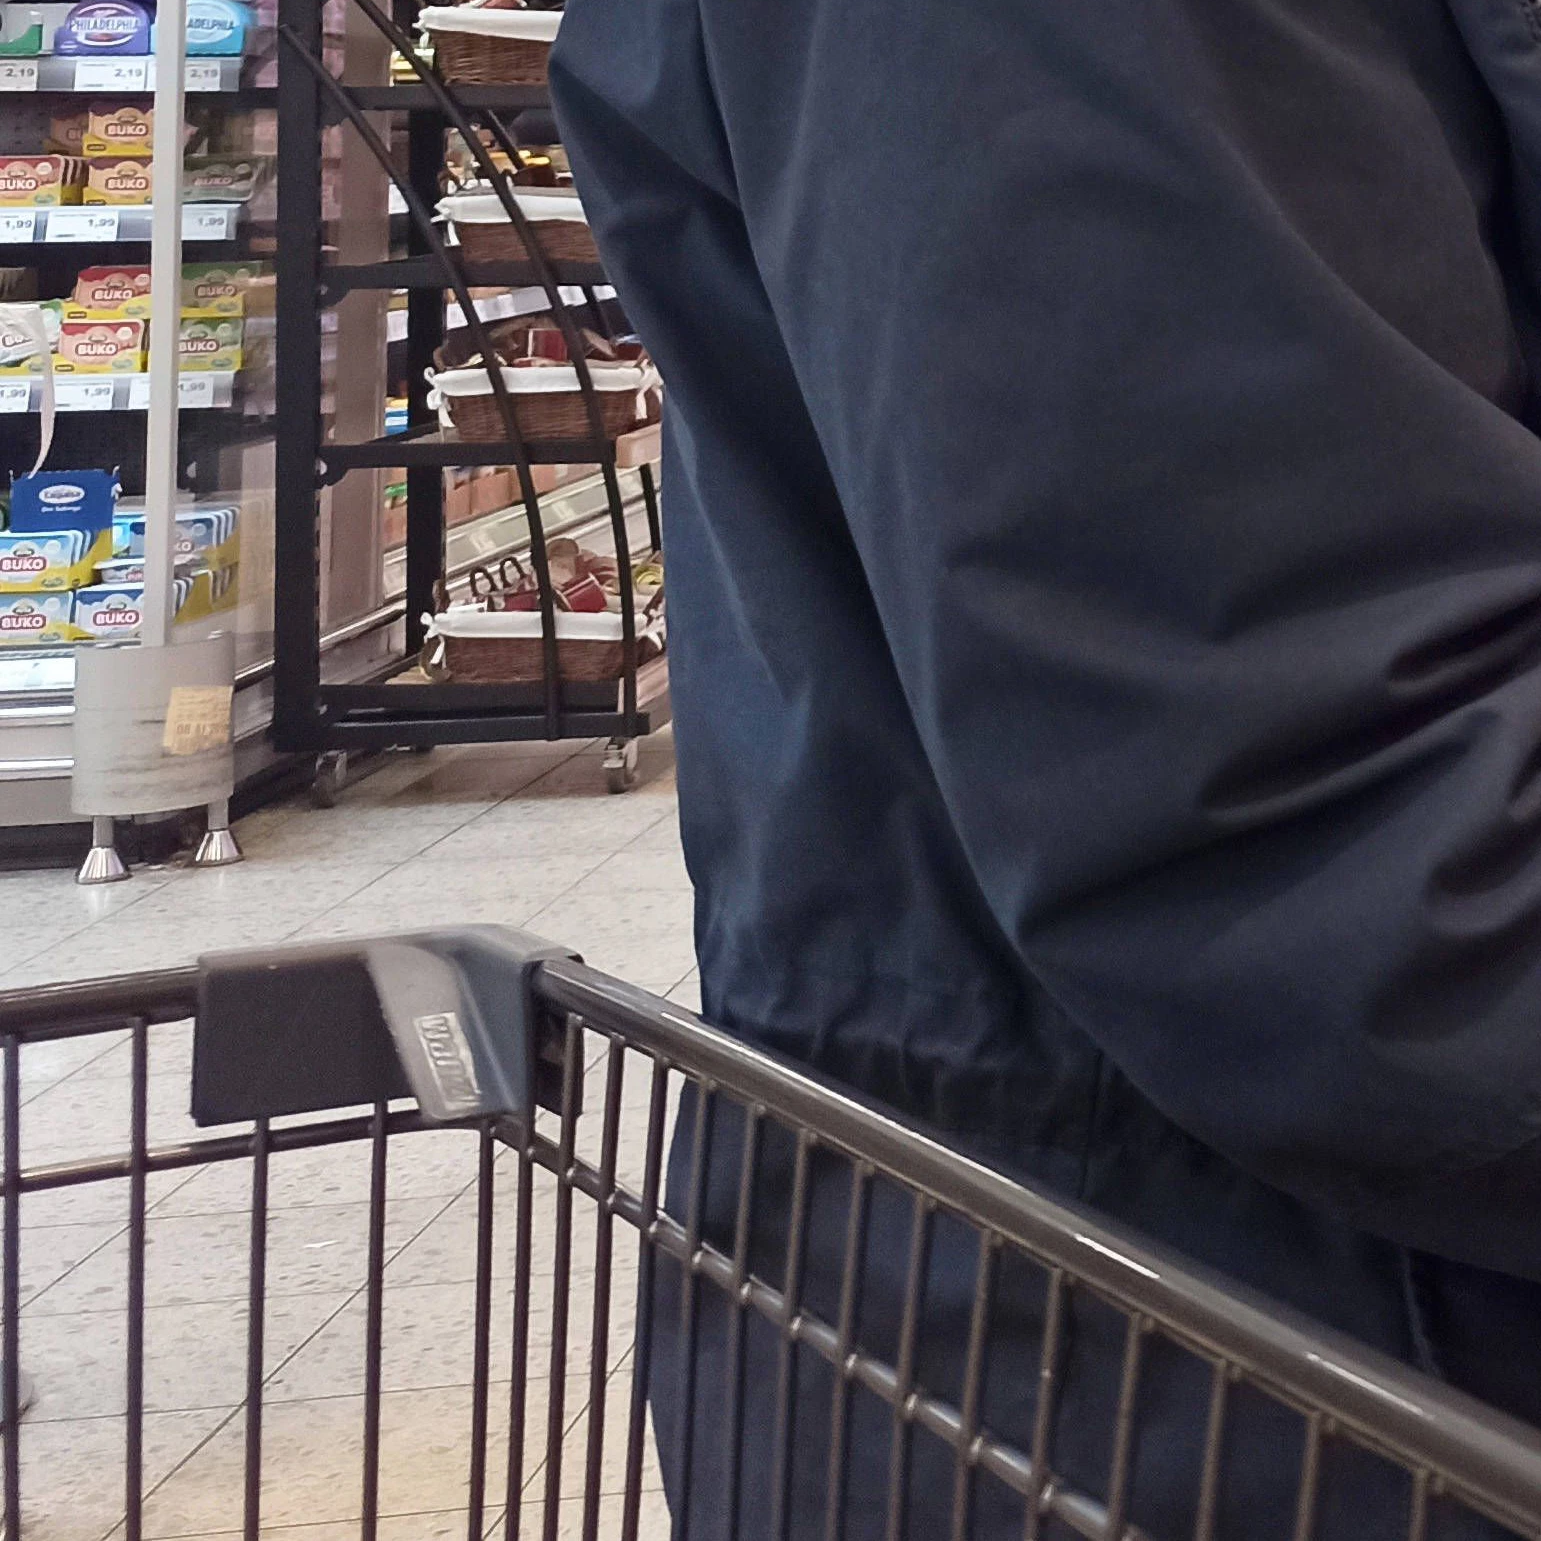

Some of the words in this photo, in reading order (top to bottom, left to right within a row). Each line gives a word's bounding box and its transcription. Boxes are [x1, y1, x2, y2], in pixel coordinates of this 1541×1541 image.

[71, 16, 140, 33] PHILADELPHIA
[114, 67, 143, 78] 2,19
[107, 124, 147, 137] BUKO
[107, 177, 146, 190] BUKO
[95, 289, 133, 301] BUKO
[198, 285, 237, 297] BUKO
[78, 343, 118, 356] BUKO
[179, 339, 218, 352] BUKO
[2, 558, 45, 571] BUKO
[2, 616, 45, 629] BUKO
[96, 611, 140, 625] BUKO
